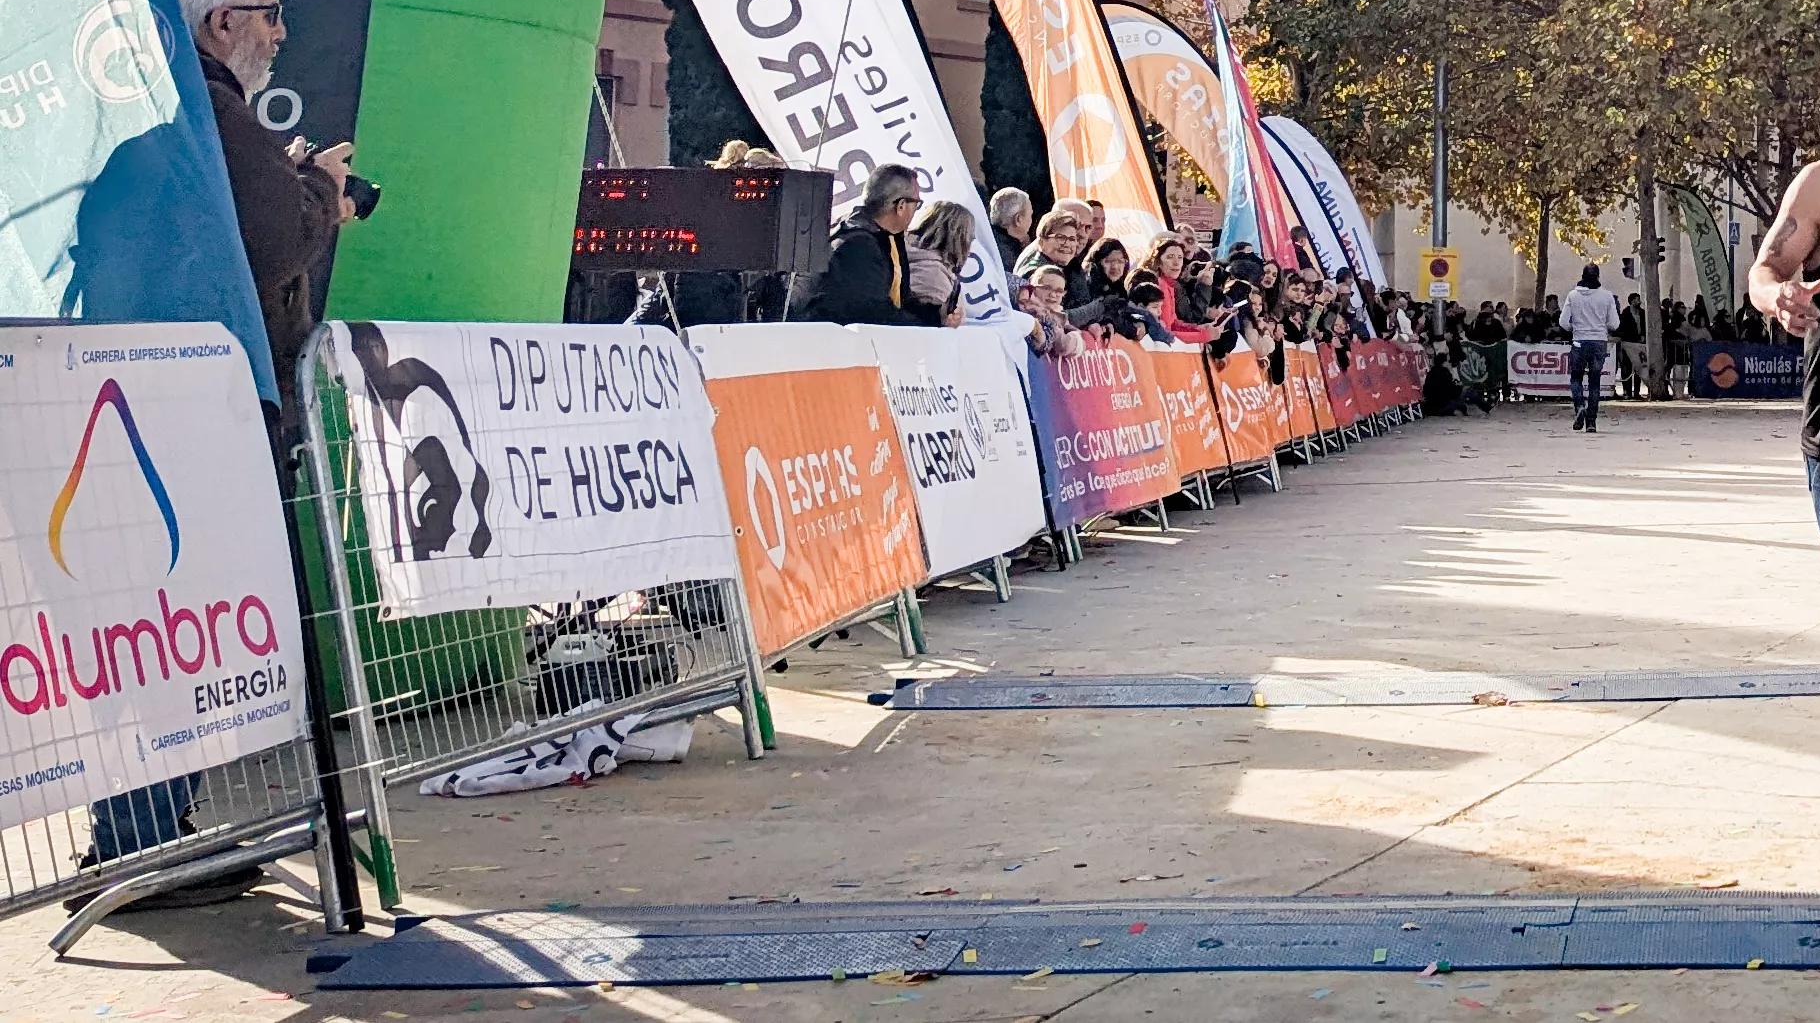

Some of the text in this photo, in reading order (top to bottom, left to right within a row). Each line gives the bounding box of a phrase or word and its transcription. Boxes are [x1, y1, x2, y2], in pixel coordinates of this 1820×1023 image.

[82, 349, 126, 364] CARRERA
[129, 346, 177, 362] EMPRESAS
[490, 327, 681, 413] DIPUTACIÓN
[1744, 356, 1792, 374] Nicolás
[505, 439, 698, 519] DE HUESCA
[0, 588, 279, 715] alumbra
[194, 659, 287, 715] ENERGÍA
[151, 730, 195, 752] CARRERA
[197, 713, 245, 738] EMPRESAS
[26, 760, 86, 789] MONZÓNCM
